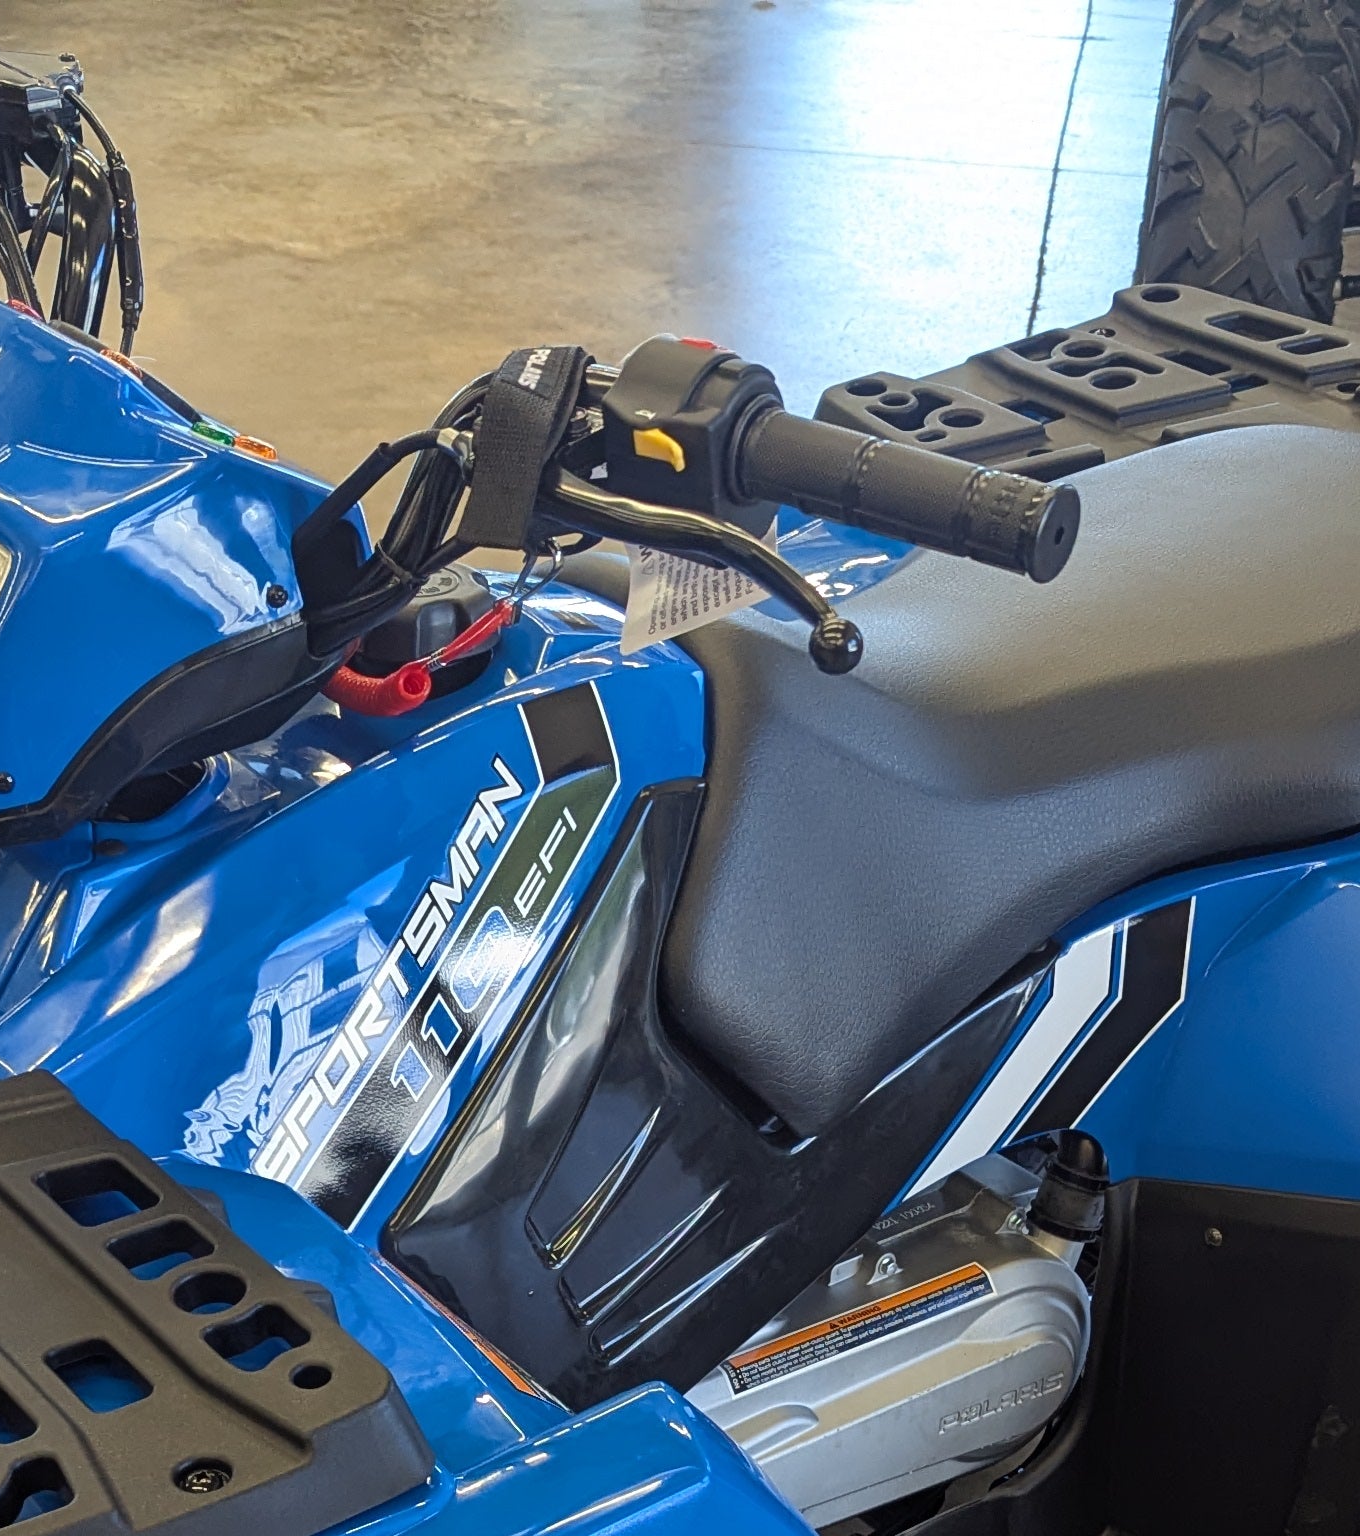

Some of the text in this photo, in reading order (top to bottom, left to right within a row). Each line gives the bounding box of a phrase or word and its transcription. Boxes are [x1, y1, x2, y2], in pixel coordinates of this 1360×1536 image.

[513, 807, 578, 917] EFI
[252, 755, 525, 1182] SPORTSMAN
[391, 905, 517, 1102] 110
[838, 1306, 881, 1325] WARNING
[772, 1357, 786, 1366] clutch
[938, 1371, 1064, 1436] POLARIS
